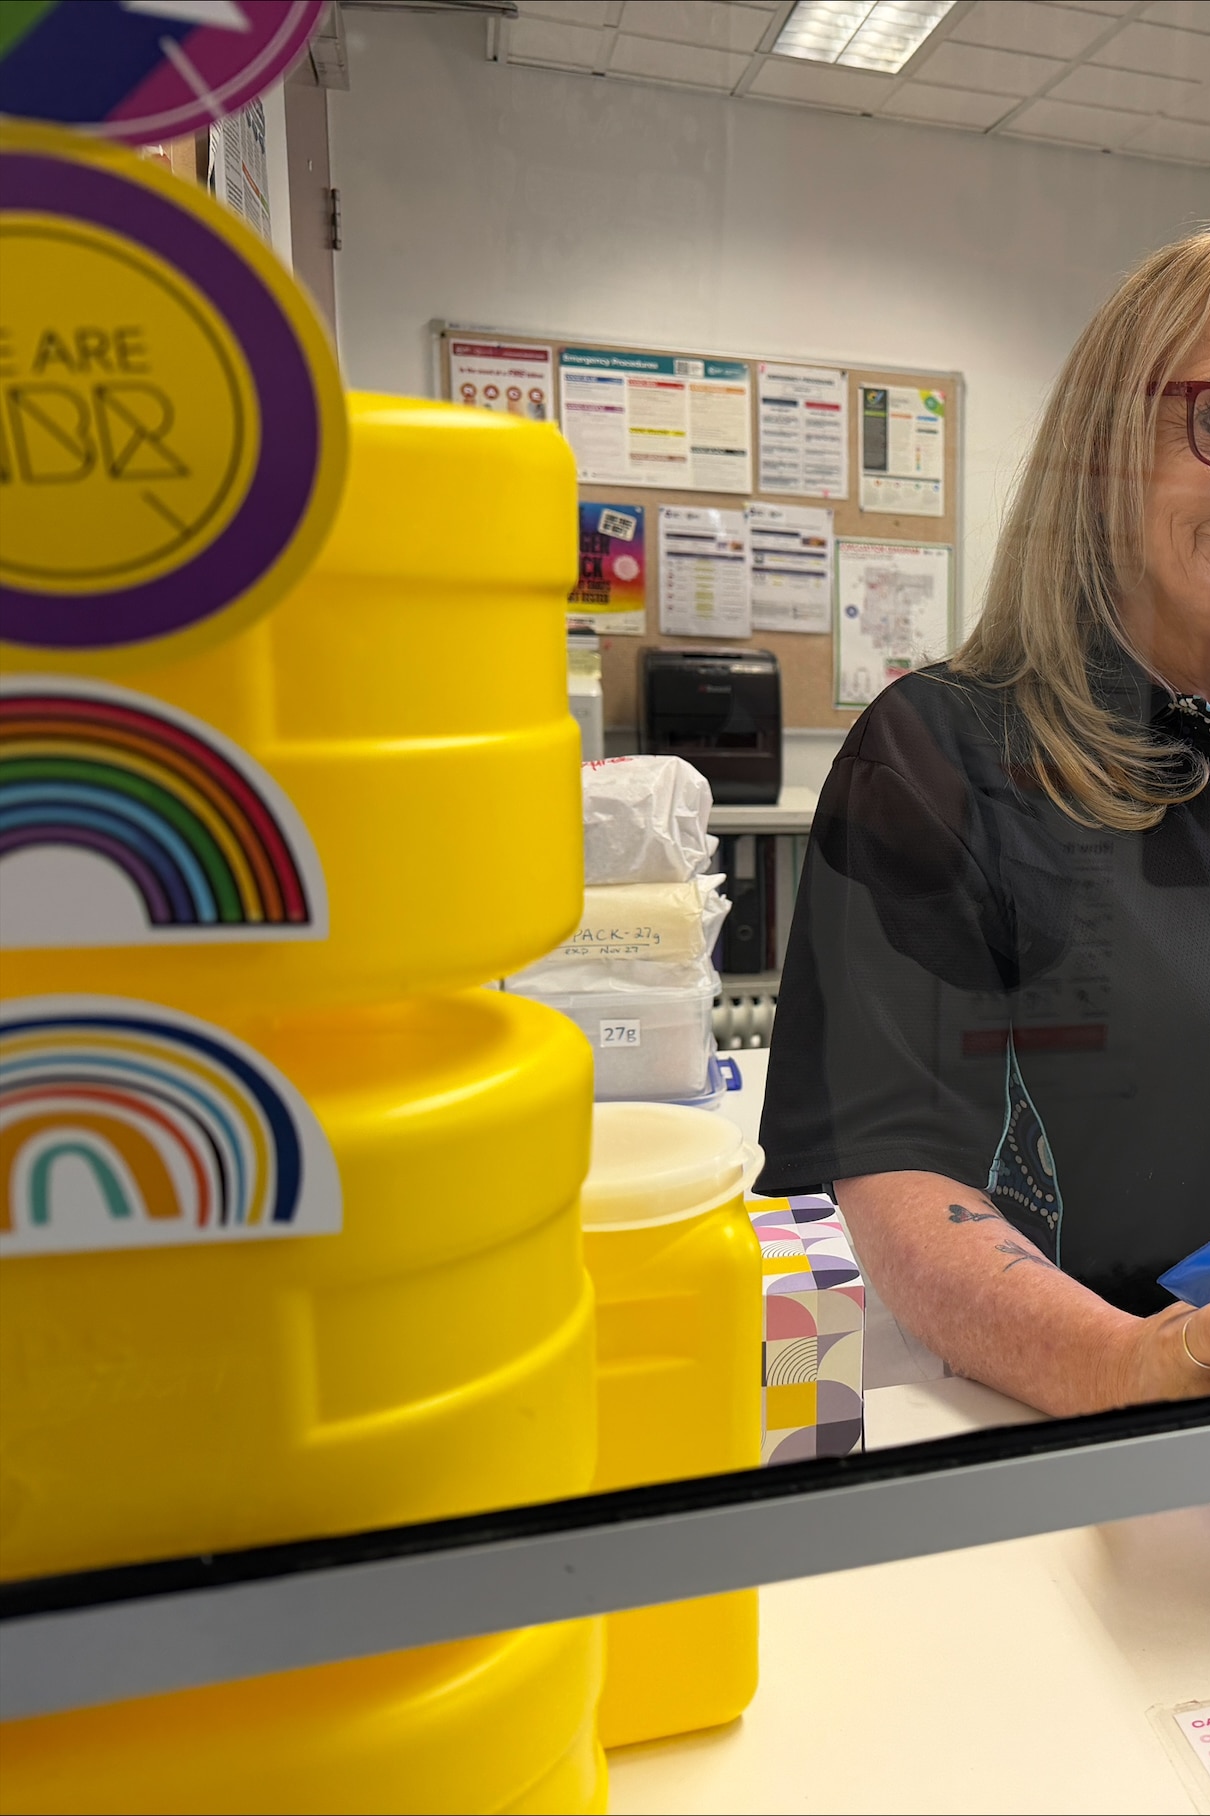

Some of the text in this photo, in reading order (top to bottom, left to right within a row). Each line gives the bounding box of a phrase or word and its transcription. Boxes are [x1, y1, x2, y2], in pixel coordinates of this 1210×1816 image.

[32, 326, 149, 375] ARE
[0, 381, 190, 486] BR
[603, 1026, 637, 1043] 27g
